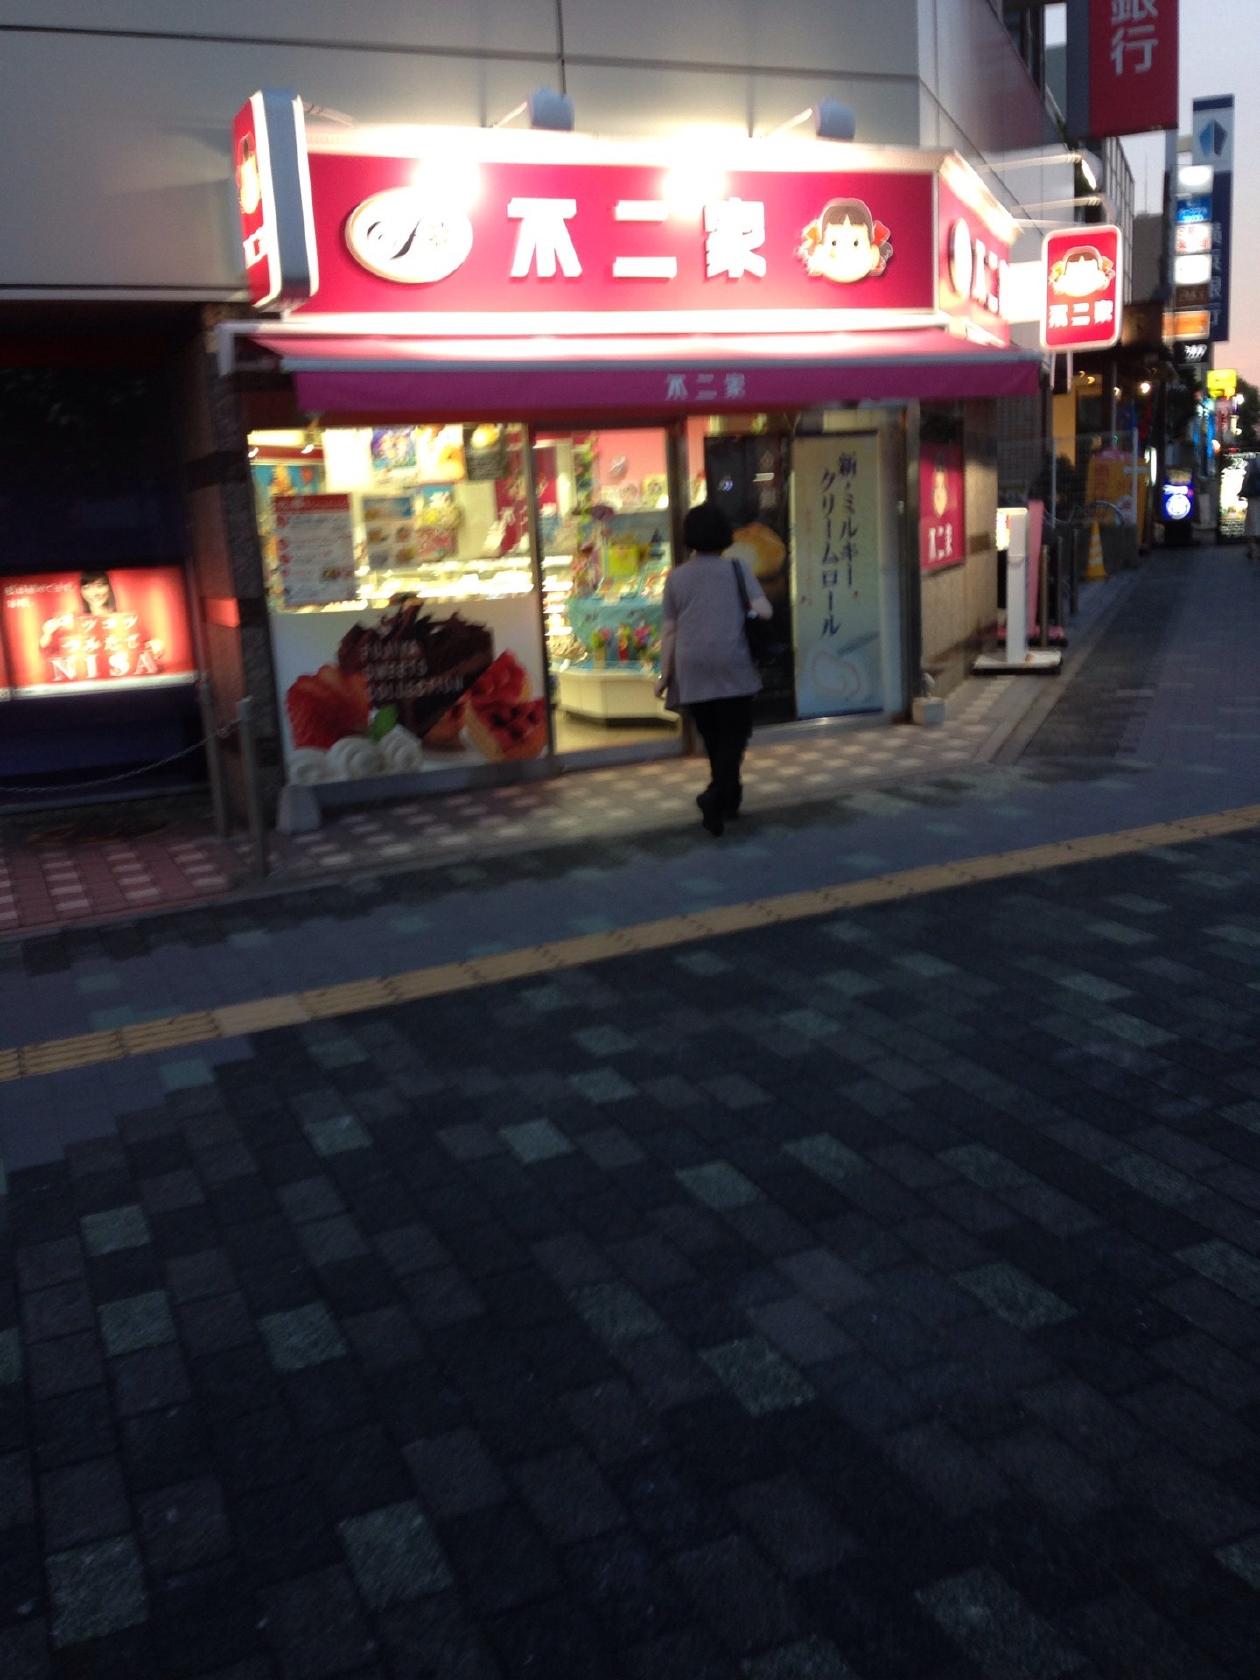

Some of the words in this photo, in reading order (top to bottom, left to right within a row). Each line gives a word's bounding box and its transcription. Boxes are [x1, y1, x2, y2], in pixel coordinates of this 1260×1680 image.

[507, 197, 767, 280] 不二家
[1048, 299, 1114, 328] 不二家
[665, 372, 746, 399] 不二家
[821, 468, 841, 640] クリームロール
[49, 650, 159, 682] NISA
